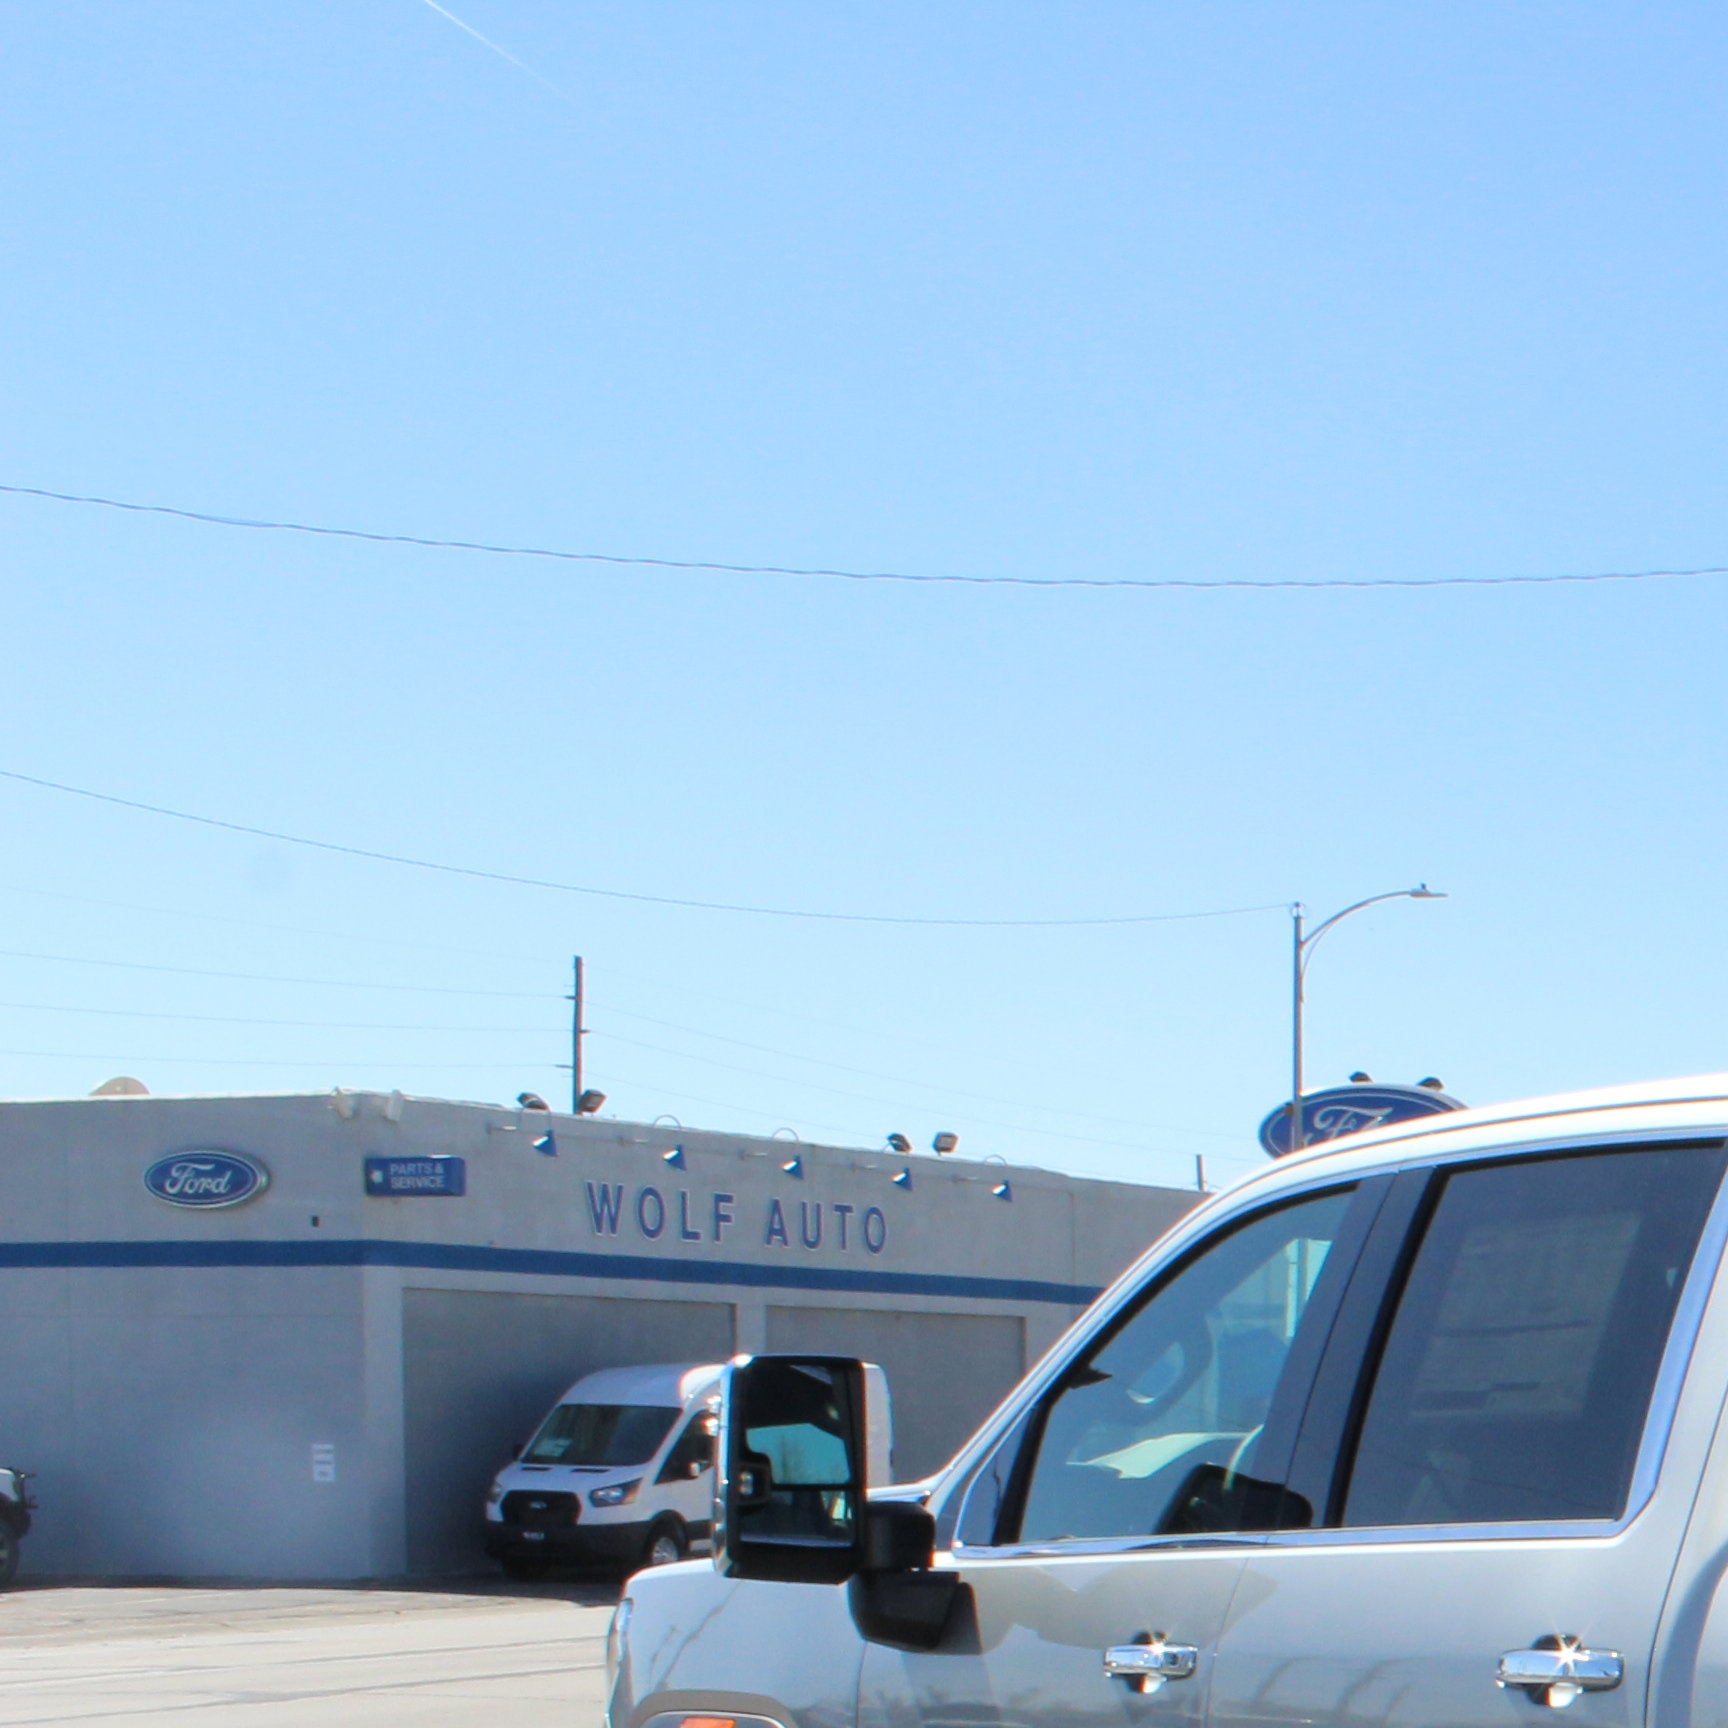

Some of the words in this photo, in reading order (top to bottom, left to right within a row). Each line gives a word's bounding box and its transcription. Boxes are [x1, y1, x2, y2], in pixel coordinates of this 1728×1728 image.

[164, 1162, 232, 1195] Ford
[390, 1163, 433, 1176] PARTS
[390, 1176, 445, 1189] SERVICE
[585, 1180, 735, 1242] WOLF
[764, 1197, 887, 1254] AUTO
